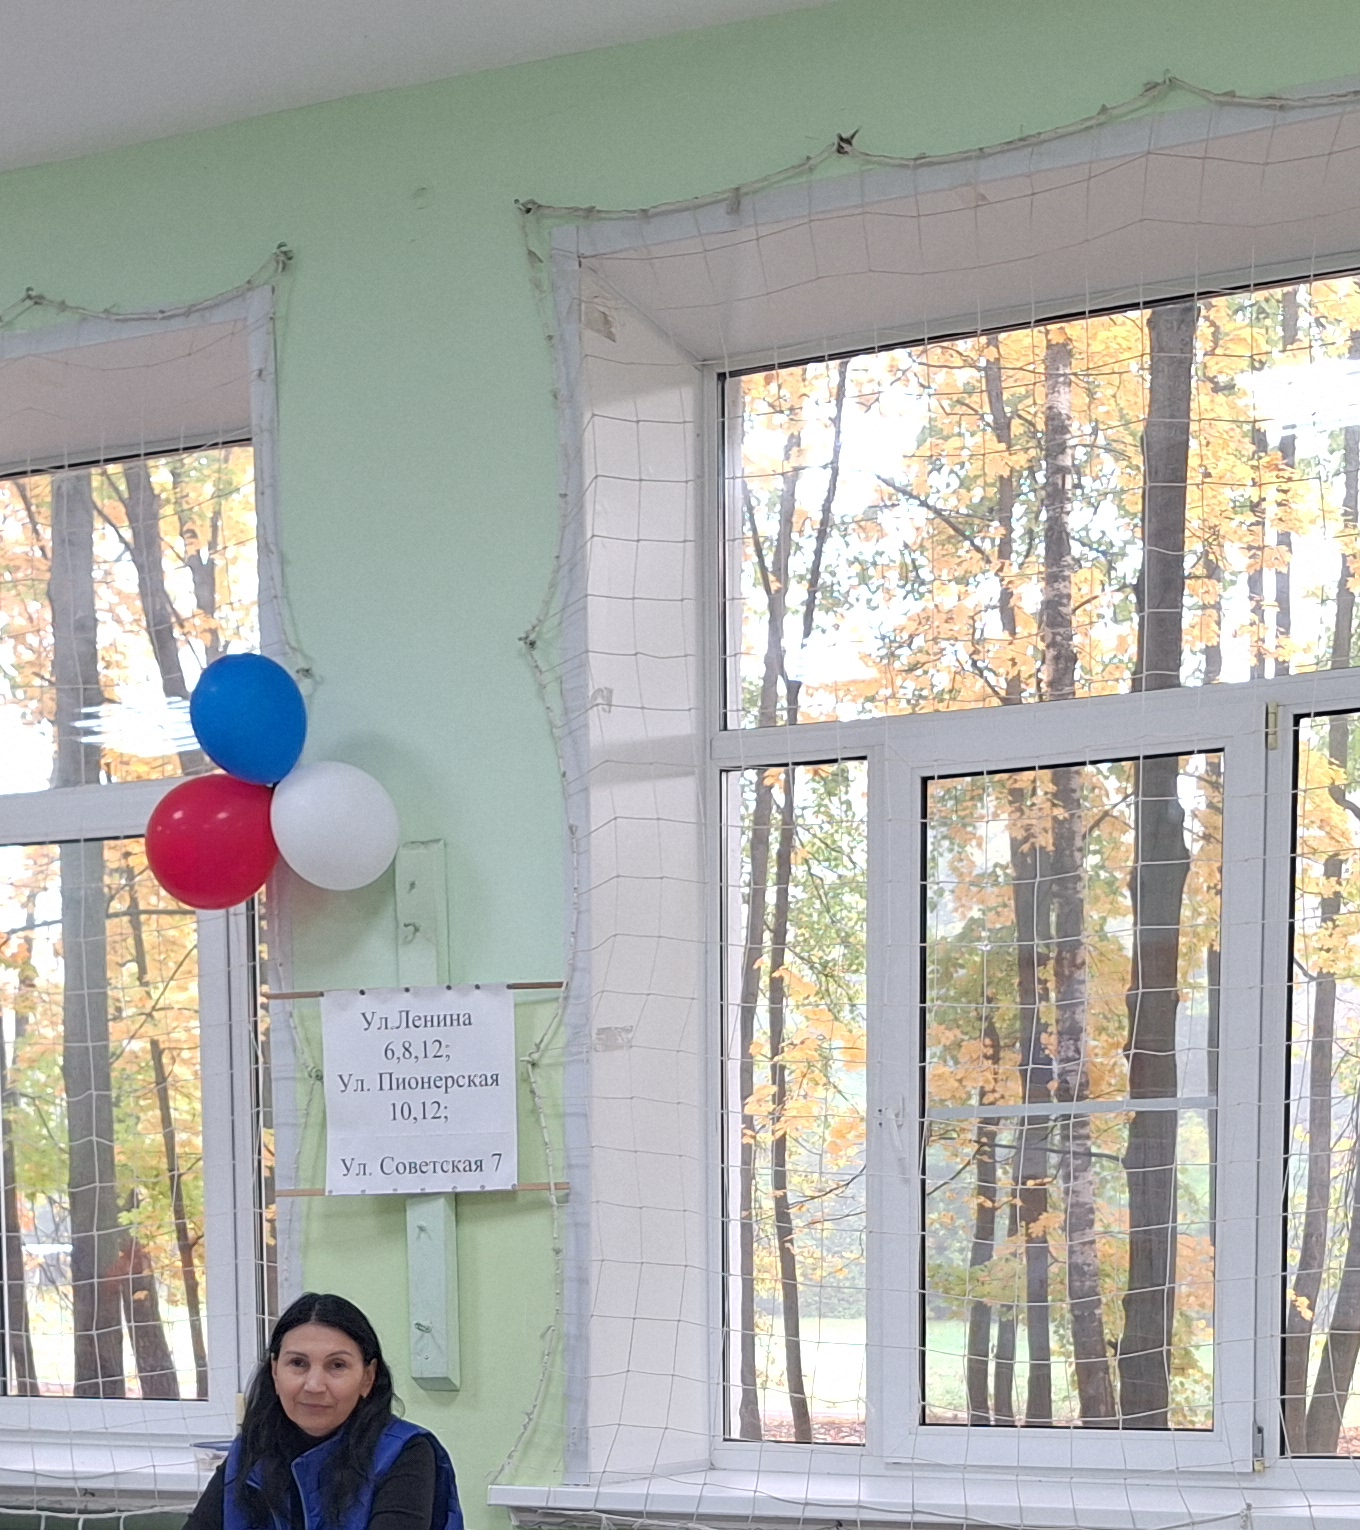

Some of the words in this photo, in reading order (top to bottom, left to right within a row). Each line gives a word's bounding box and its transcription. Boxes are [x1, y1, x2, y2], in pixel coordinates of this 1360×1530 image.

[360, 1009, 473, 1032] Ул.Ленина
[384, 1039, 451, 1064] 6,8,12;
[337, 1073, 371, 1094] Ул.
[378, 1071, 500, 1095] Пионерская
[391, 1100, 449, 1125] 10,12;
[340, 1157, 373, 1177] Ул.
[379, 1156, 484, 1176] Советская
[490, 1152, 503, 1172] 7
